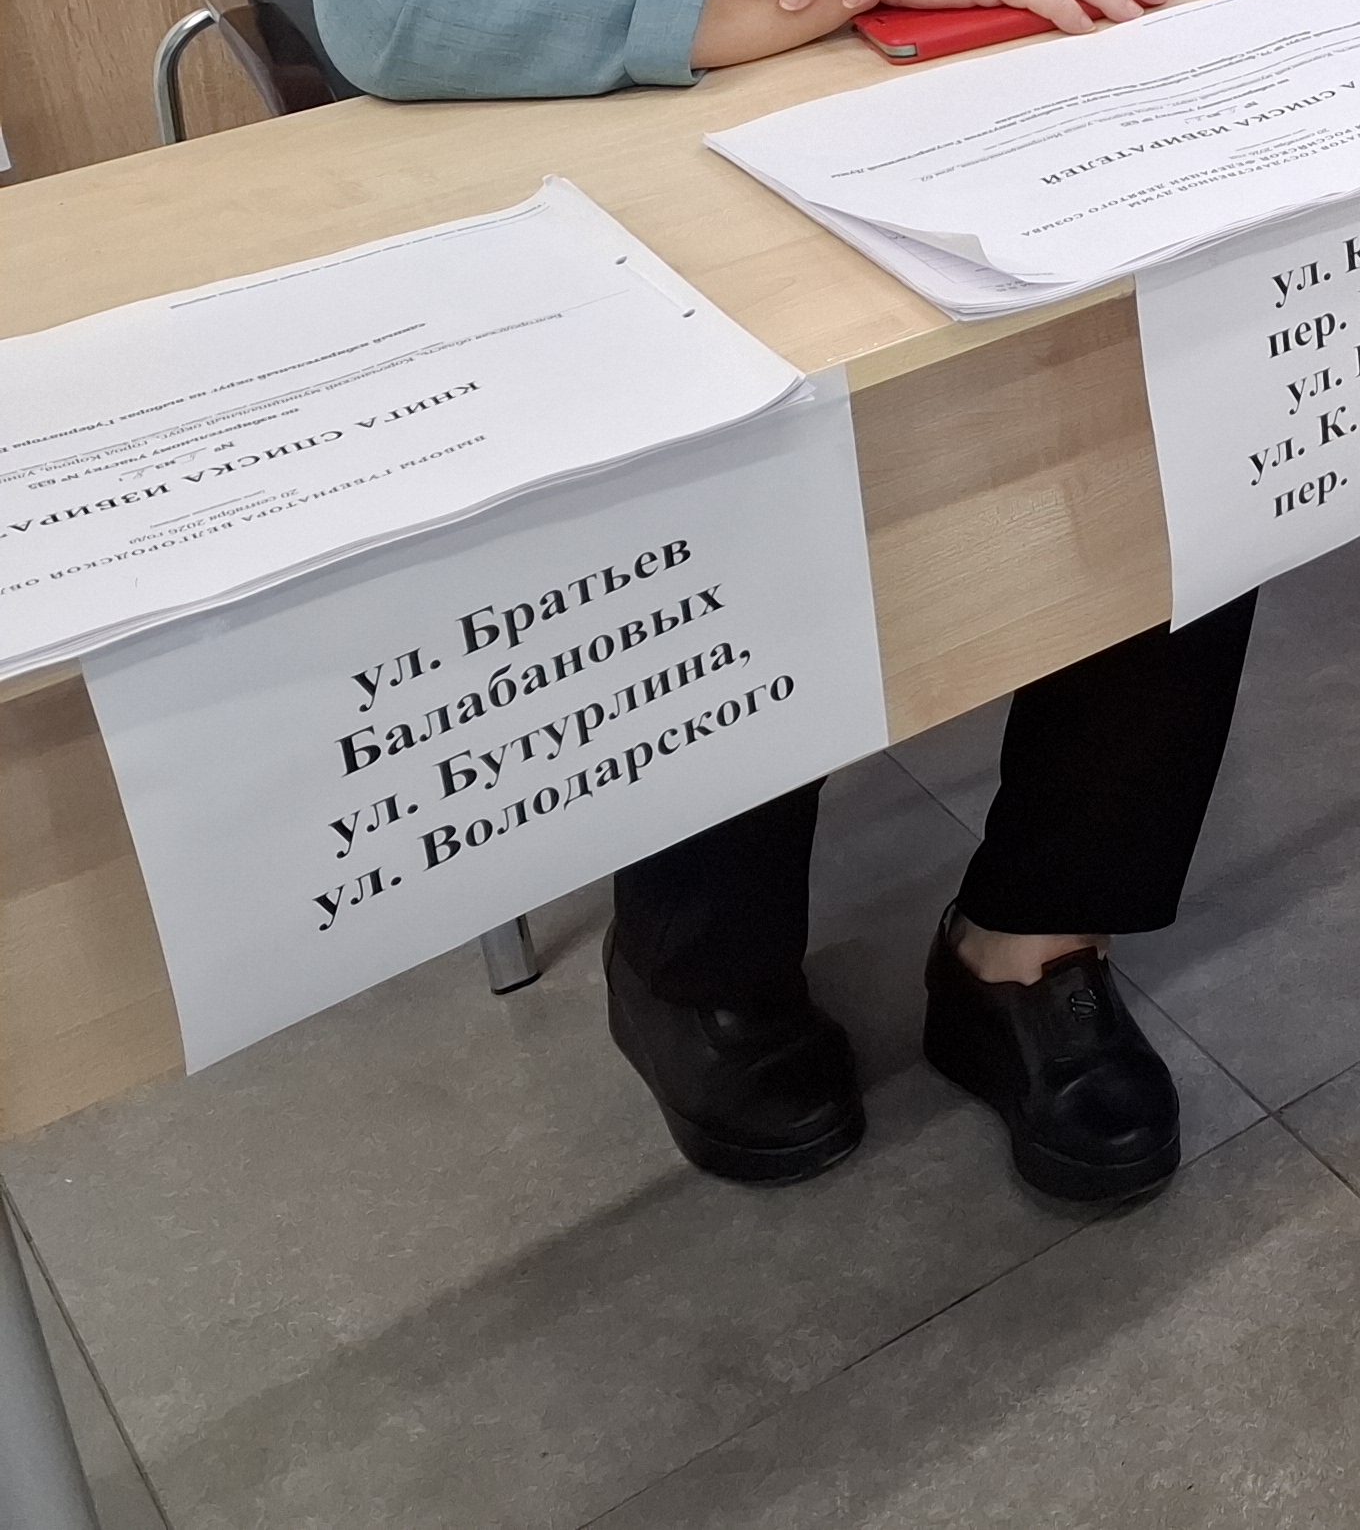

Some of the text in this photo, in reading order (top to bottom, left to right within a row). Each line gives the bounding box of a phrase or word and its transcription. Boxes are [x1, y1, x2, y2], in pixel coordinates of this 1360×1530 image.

[1233, 90, 1337, 128] СПИСКА
[1039, 125, 1232, 186] ИЗБИРАТЕЛЕЙ
[1259, 129, 1352, 162] РОССИЙСКОЙ
[1169, 159, 1256, 186] ФЕДЕРАЦИИ
[1177, 148, 1317, 192] ГОСУДАРСТВЕННОЙ
[1088, 182, 1165, 214] ДЕВЯТОГО
[1127, 189, 1173, 209] ДУМЫ
[1020, 212, 1084, 237] СОЗЫВА
[1270, 259, 1332, 308] ул.
[1266, 308, 1348, 360] пер.
[280, 406, 300, 417] по
[353, 380, 484, 429] КНИГА
[1286, 371, 1344, 415] ул.
[12, 418, 114, 450] Губернатора
[151, 413, 278, 458] избирательному
[180, 428, 344, 485] СПИСКА
[212, 440, 236, 454] №
[399, 433, 486, 470] ВЫБОРЫ
[1248, 440, 1306, 487] ул.
[1317, 407, 1359, 449] К.
[60, 472, 79, 484] №
[83, 452, 148, 476] участку
[128, 487, 298, 546] 20 сентября 2026 года
[240, 467, 393, 523] ГУБЕРНАТОРА
[1272, 470, 1349, 520] пер.
[49, 521, 234, 580] БЕЛГОРОДСКОЙ
[351, 532, 695, 713] ул. Братьев
[334, 579, 727, 780] Балабановых
[327, 630, 754, 859] ул. Бутурлина,
[311, 670, 797, 934] ул. Володарского
